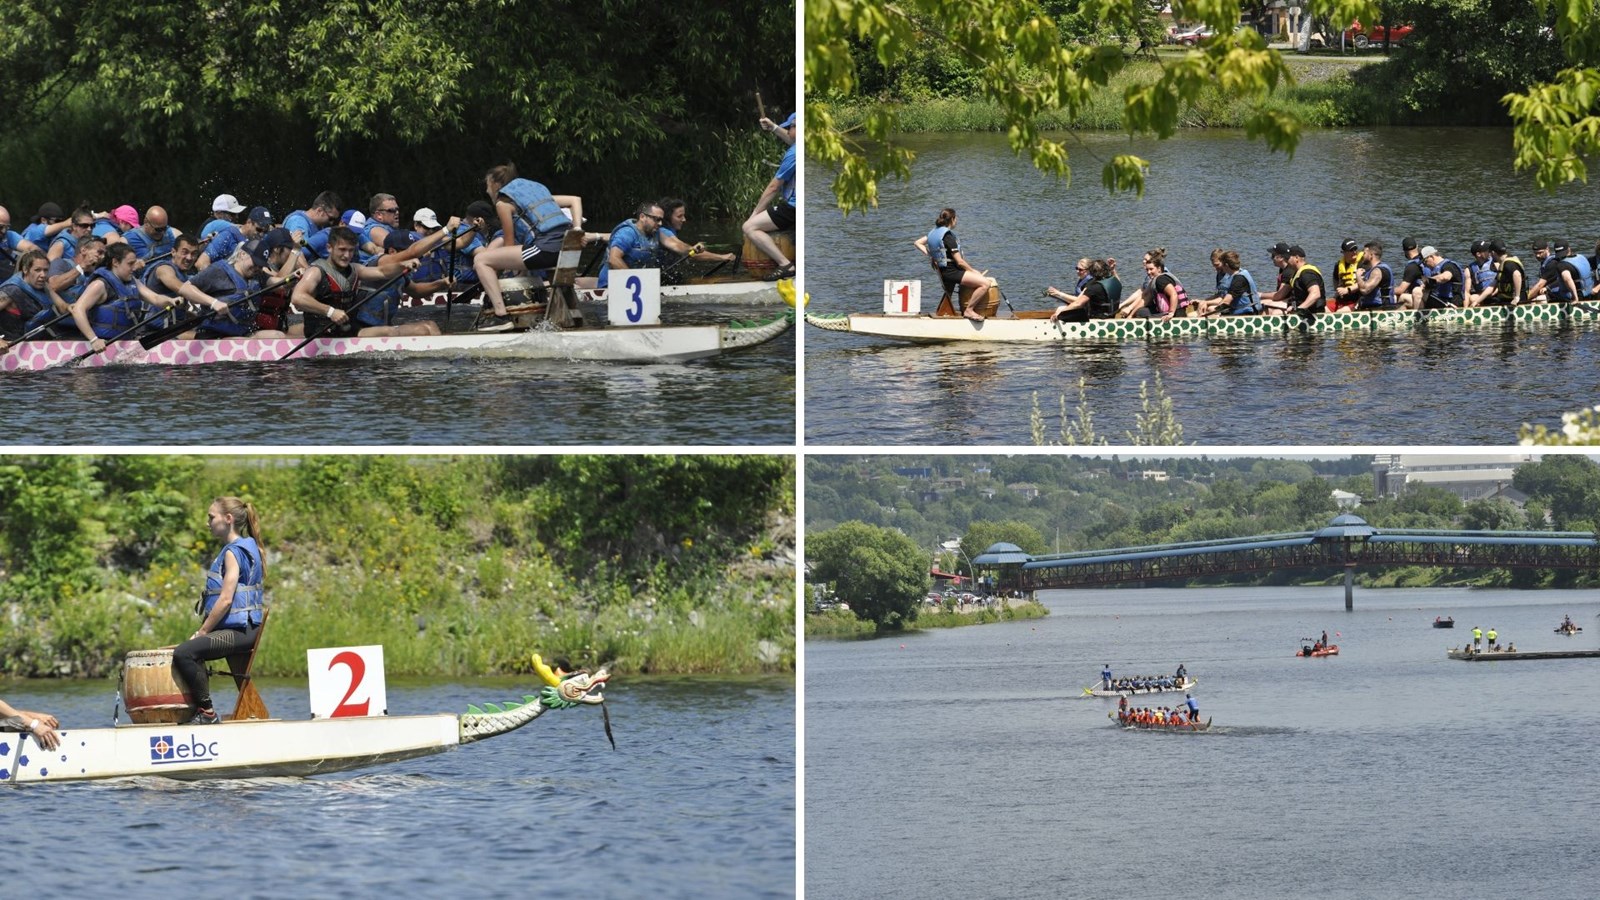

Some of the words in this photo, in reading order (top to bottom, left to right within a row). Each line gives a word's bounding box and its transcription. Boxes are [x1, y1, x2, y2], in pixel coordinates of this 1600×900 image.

[626, 276, 643, 323] 3
[897, 285, 909, 313] 1
[328, 651, 370, 718] 2
[176, 734, 218, 758] ebc
